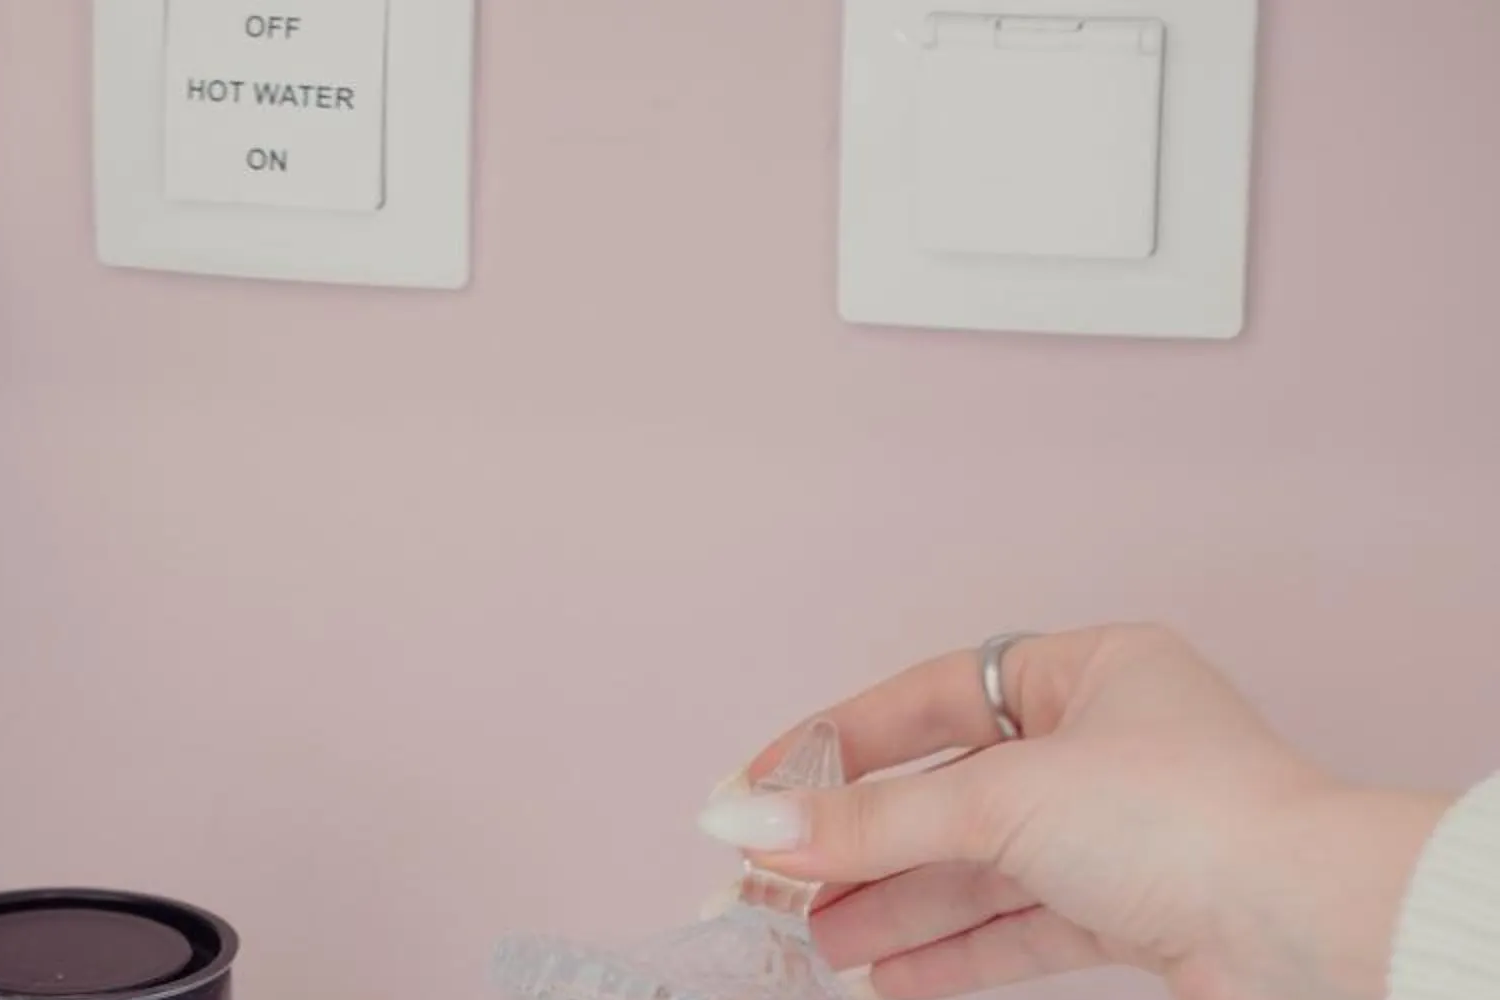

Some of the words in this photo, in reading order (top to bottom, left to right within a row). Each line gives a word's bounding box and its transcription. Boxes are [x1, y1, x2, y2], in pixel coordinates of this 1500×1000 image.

[245, 15, 301, 39] OFF
[187, 78, 244, 103] HOT
[253, 82, 355, 110] WATER
[246, 147, 288, 171] ON
